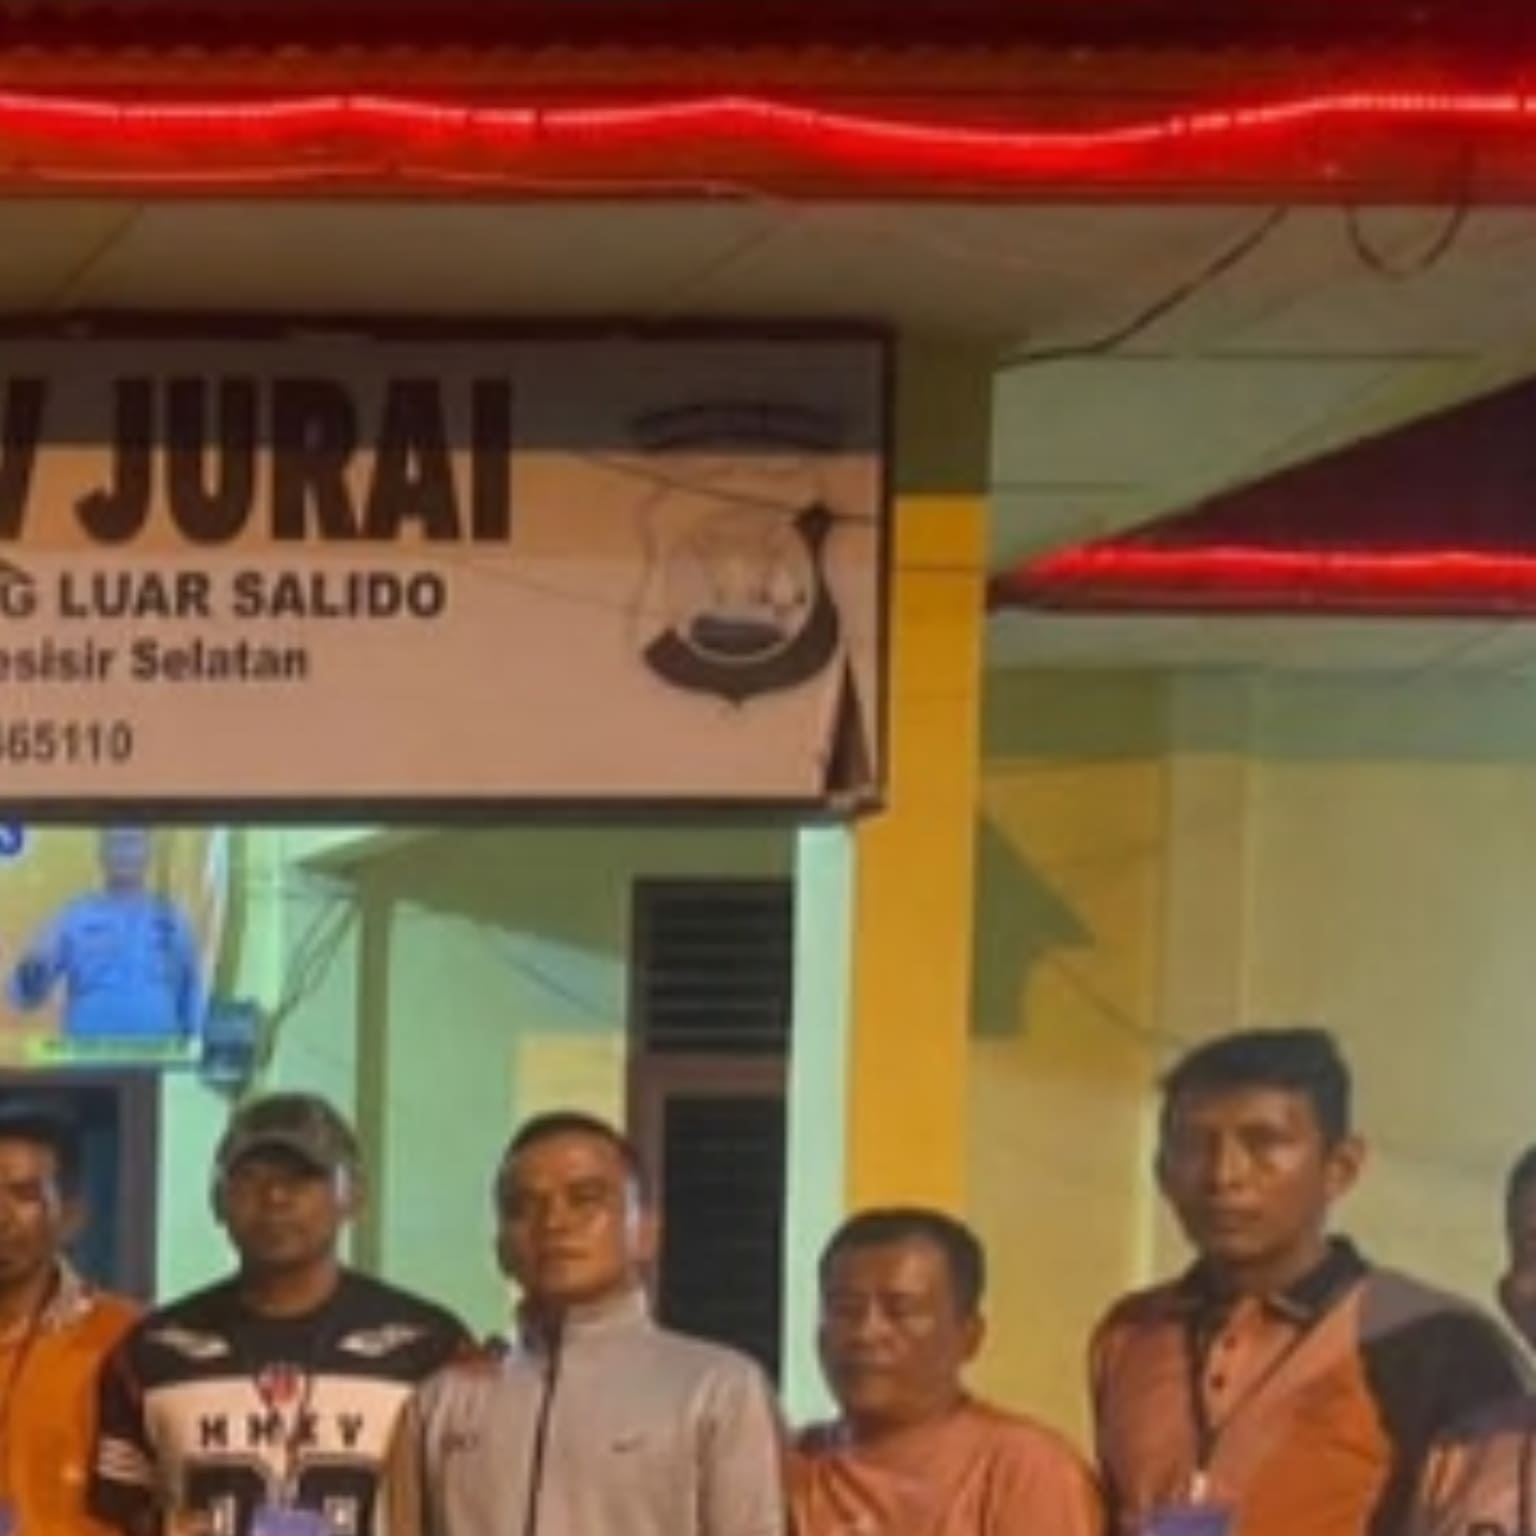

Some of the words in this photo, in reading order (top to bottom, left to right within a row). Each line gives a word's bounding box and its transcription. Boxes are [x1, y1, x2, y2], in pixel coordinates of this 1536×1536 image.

[73, 377, 512, 543] JURAI
[59, 571, 213, 619] LUAR
[232, 571, 448, 619] SALIDO
[131, 640, 310, 682] Selatan
